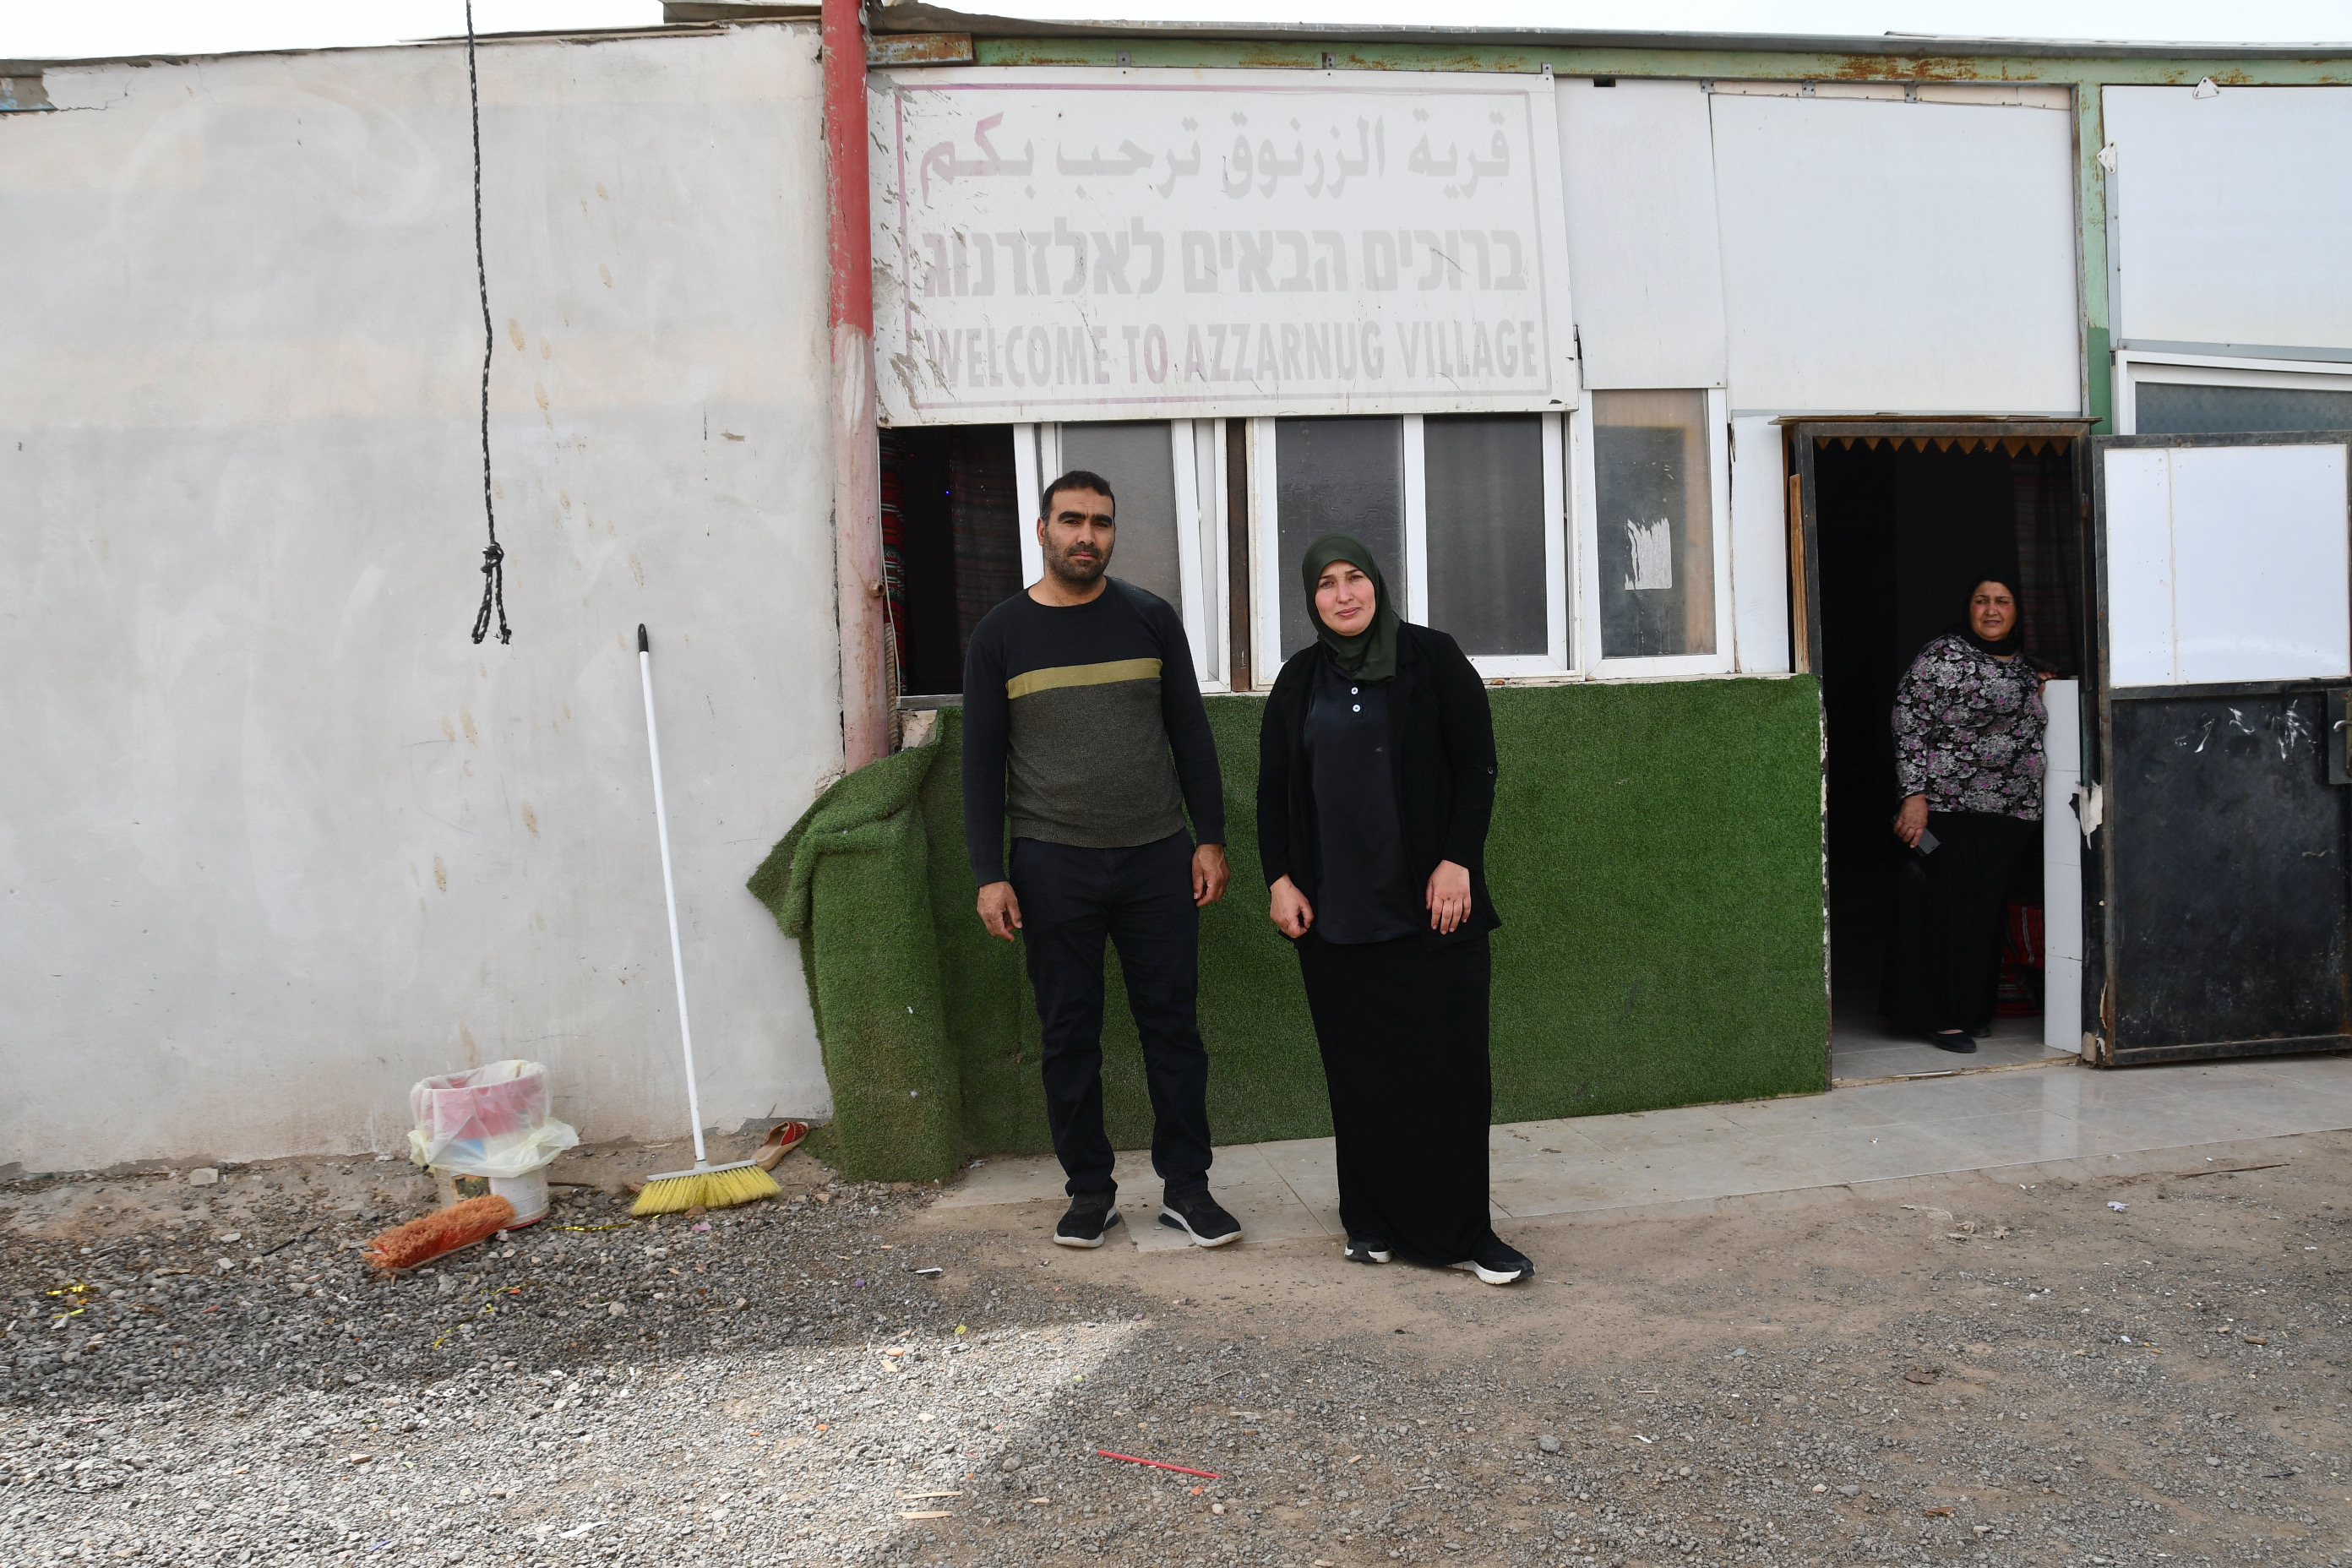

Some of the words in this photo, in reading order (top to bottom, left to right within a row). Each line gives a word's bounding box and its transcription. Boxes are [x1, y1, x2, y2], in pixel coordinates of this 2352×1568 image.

[920, 112, 1035, 205] بكم
[1056, 117, 1201, 199] ترحب
[1222, 111, 1386, 200] الزرنوق
[1407, 107, 1511, 200] قرية
[1181, 229, 1350, 294] הבאים
[1362, 229, 1527, 292] ברוכים
[925, 325, 1110, 388] WELCOME
[1122, 323, 1168, 384] TO
[1184, 321, 1385, 383] AZZARNUG
[1396, 319, 1539, 379] VILLAGE
